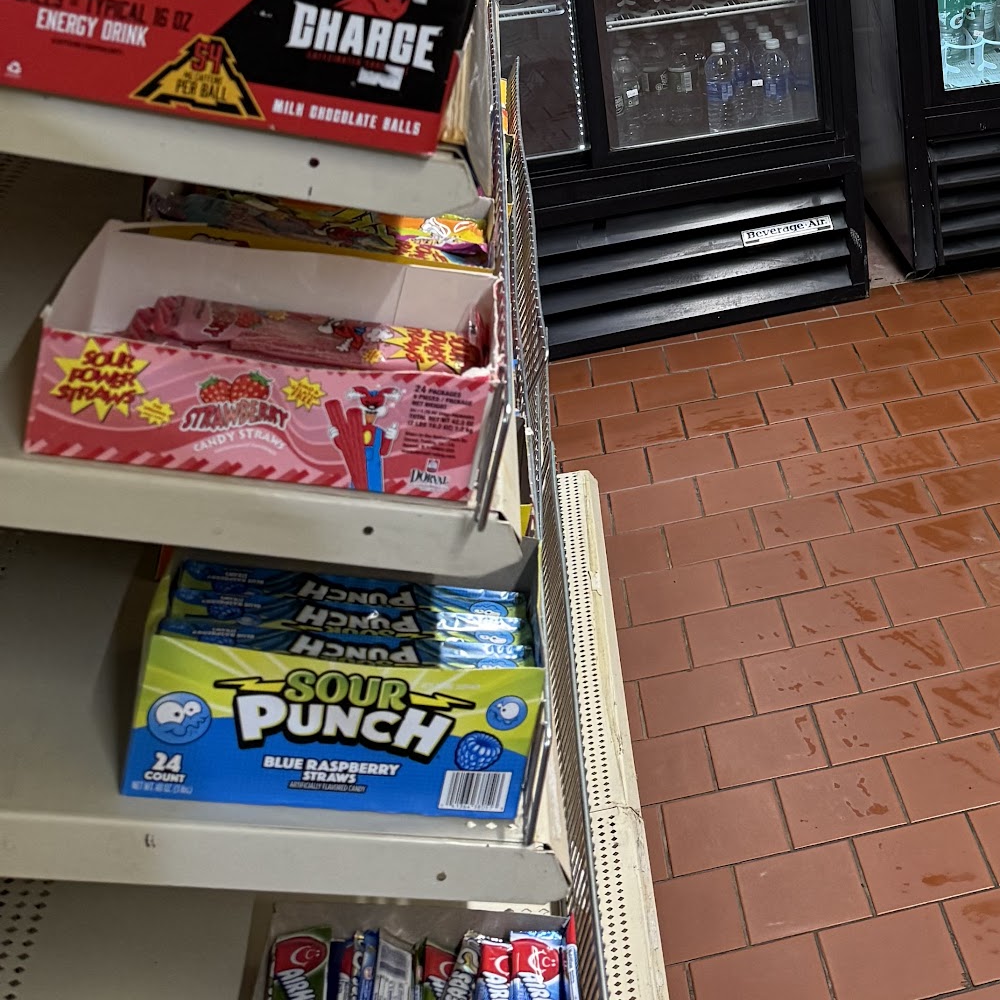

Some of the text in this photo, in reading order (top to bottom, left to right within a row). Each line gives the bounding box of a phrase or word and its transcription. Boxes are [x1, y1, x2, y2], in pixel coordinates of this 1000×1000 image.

[36, 8, 98, 38] ENERGY
[101, 19, 150, 48] DRINK
[152, 7, 169, 27] 16
[173, 11, 194, 32] OZ
[285, 0, 445, 72] CHARGE
[175, 78, 227, 101] PER BALL
[271, 98, 422, 136] MILK CHOCOLATE BALLS
[82, 350, 135, 370] SOUR
[67, 367, 138, 388] POWER
[57, 384, 137, 405] STRAWS
[415, 384, 462, 398] 24 PACKAGES
[180, 399, 290, 432] STRAWBERRY
[194, 429, 287, 452] CANDY STRAWS
[409, 468, 448, 486] DORVAL
[297, 579, 418, 608] PUNCH
[294, 604, 424, 635] PUNCH
[288, 633, 420, 665] PUNCH
[284, 668, 409, 711] SOUR
[236, 692, 455, 760] PUNCH
[152, 752, 183, 773] 24
[263, 756, 401, 777] BLUE RASPBERRY
[143, 771, 186, 784] COUNT
[301, 772, 357, 784] STRAWS
[349, 784, 367, 793] CANDY
